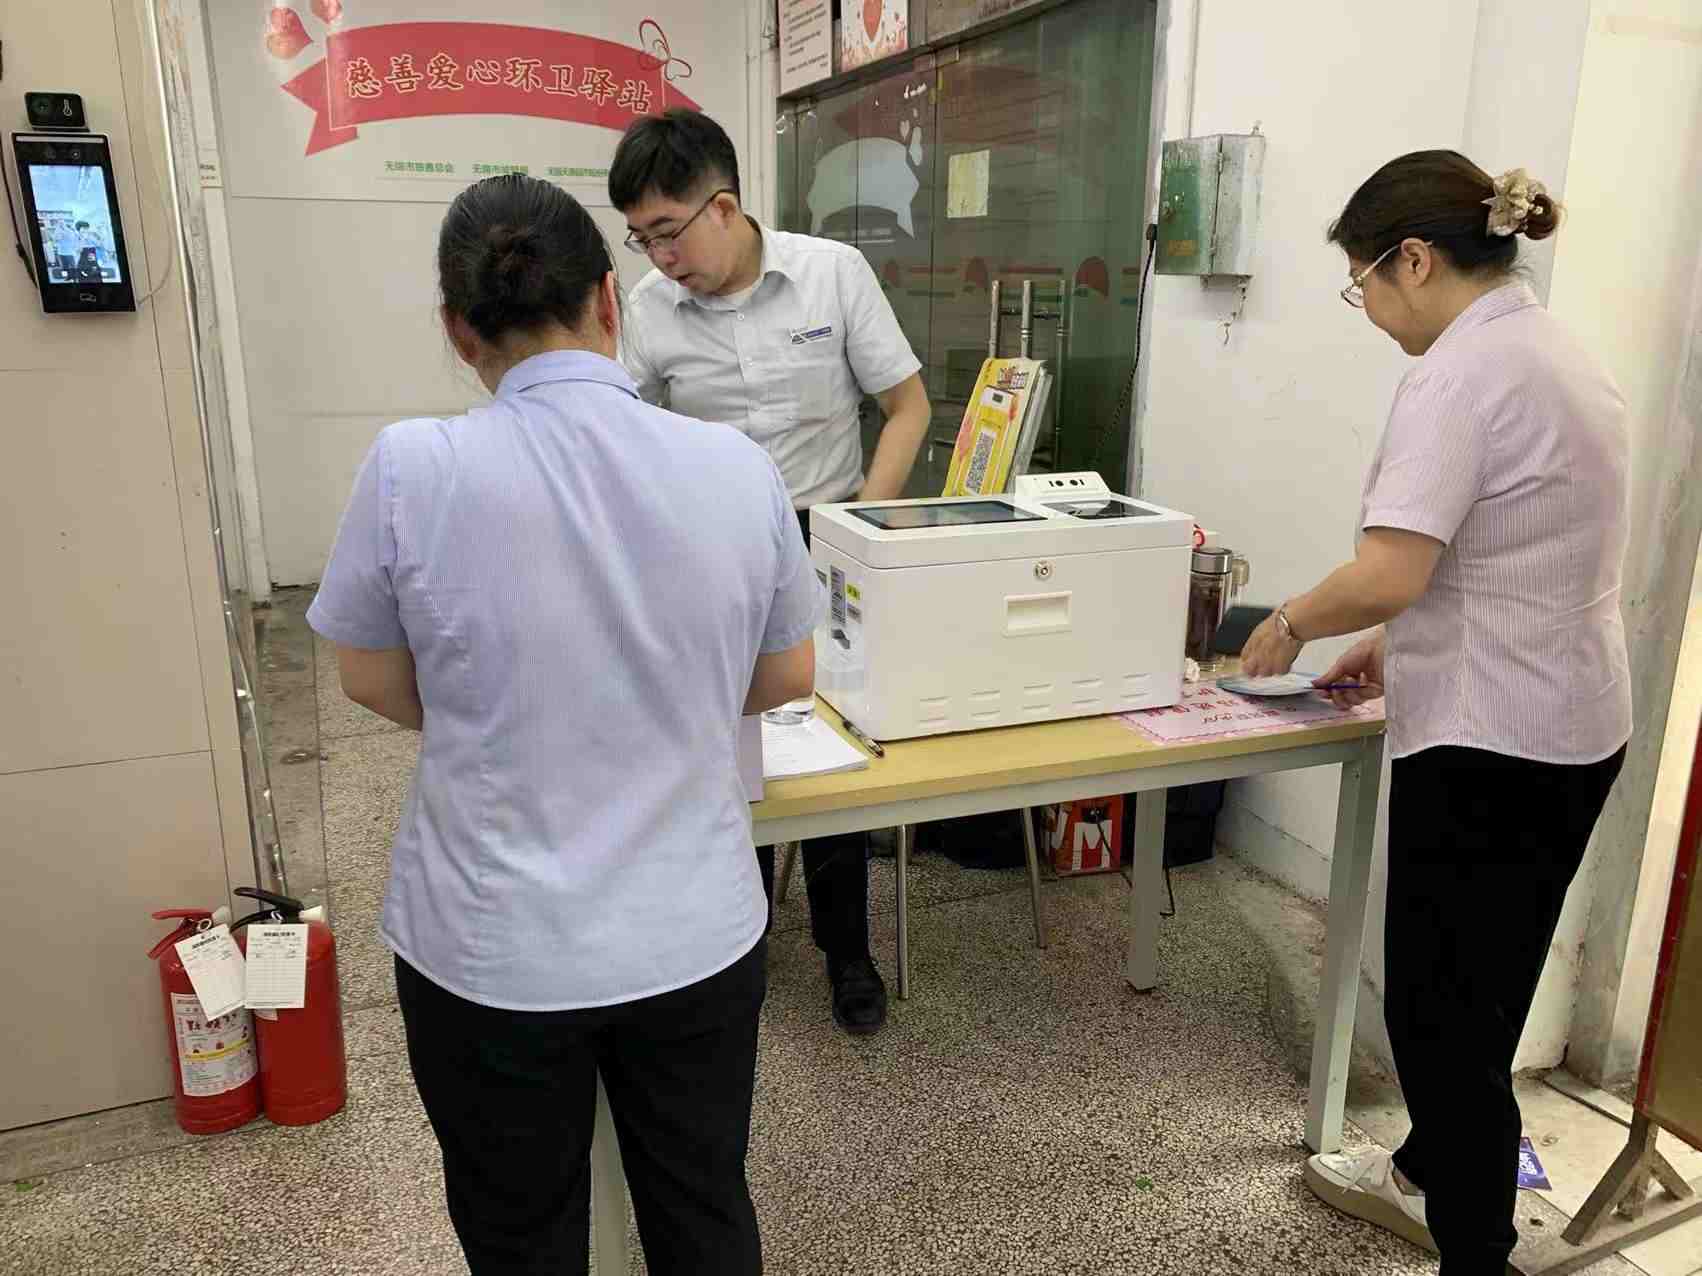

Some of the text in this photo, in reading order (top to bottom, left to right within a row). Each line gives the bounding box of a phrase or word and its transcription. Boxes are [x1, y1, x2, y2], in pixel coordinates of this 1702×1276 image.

[347, 53, 652, 114] 慈善爱心环卫驿站
